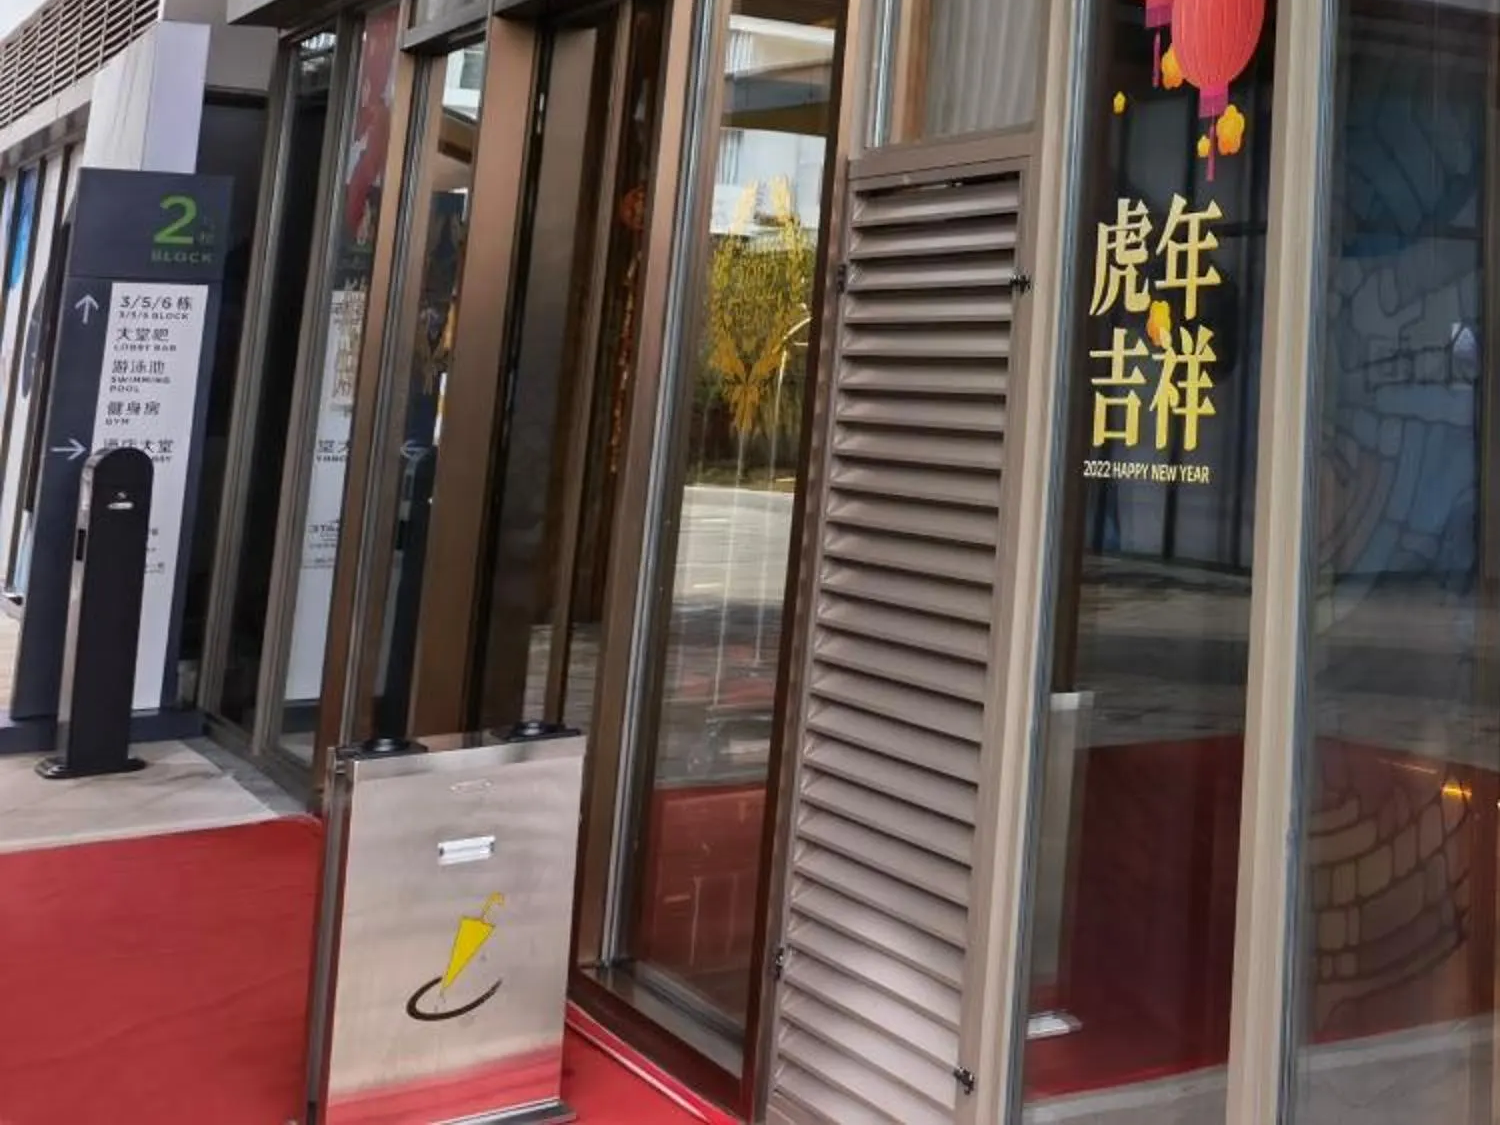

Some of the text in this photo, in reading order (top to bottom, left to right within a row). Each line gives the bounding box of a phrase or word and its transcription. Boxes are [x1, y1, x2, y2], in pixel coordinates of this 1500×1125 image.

[153, 195, 197, 245] 2
[150, 250, 212, 263] BLOCK
[1083, 460, 1210, 484] 2022 HAPPY NEW YEAR
